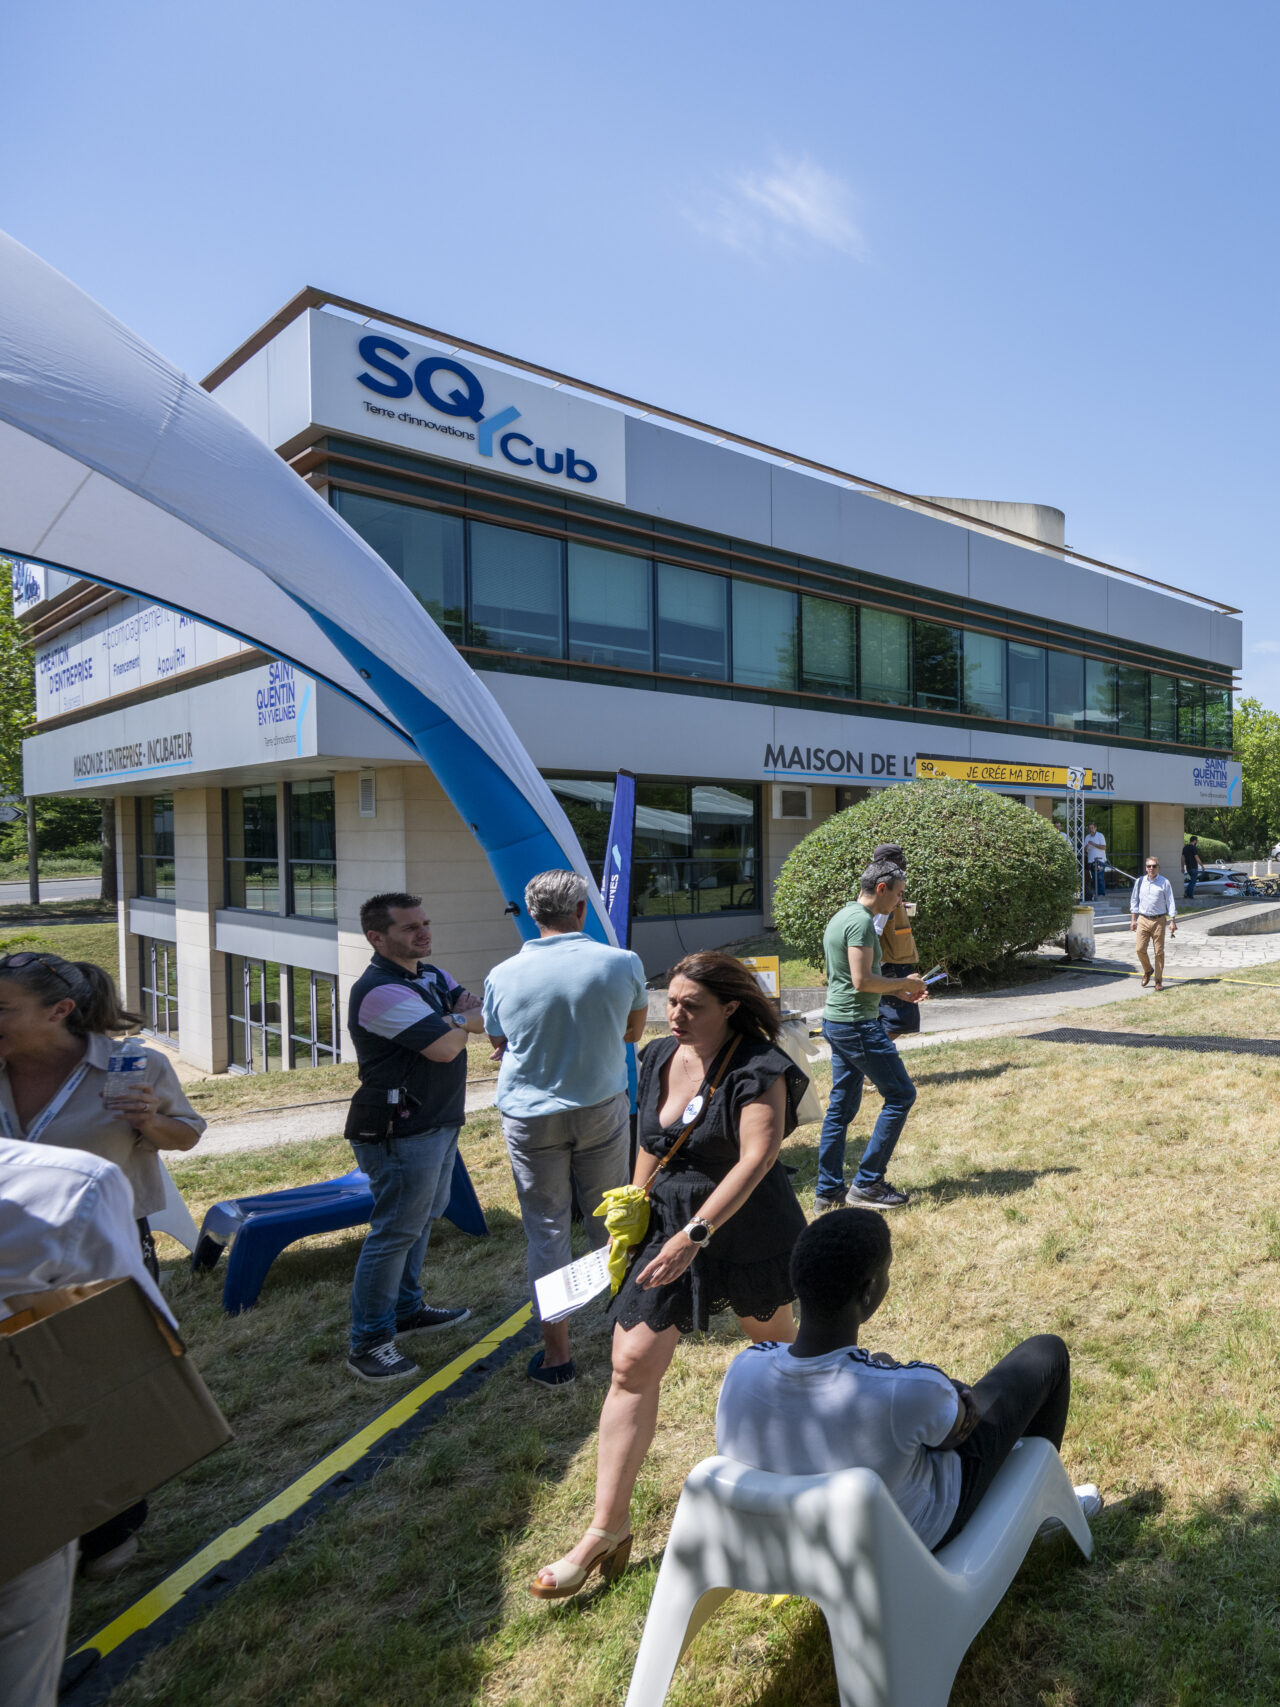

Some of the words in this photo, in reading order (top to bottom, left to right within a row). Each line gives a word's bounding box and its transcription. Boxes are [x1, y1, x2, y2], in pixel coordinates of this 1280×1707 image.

[363, 401, 396, 419] Terre
[398, 411, 476, 441] d'innovations
[500, 432, 598, 483] Cub
[176, 647, 187, 668] RH
[257, 681, 295, 710] QUENTIN
[258, 711, 267, 726] EN
[267, 705, 296, 725] YVELINES
[74, 752, 96, 777] MAISON
[96, 752, 103, 774] DE
[104, 743, 142, 772] L'ENTREPRISE
[147, 732, 193, 765] INCUBATEUR
[763, 743, 864, 774] MAISON
[871, 752, 896, 776] DE
[1205, 758, 1227, 770] SAINT
[966, 766, 979, 778] JE
[981, 765, 1007, 780] CRÉE
[1009, 768, 1023, 781] MA
[1193, 767, 1227, 781] QUENTIN
[1194, 779, 1202, 787] EN
[1203, 780, 1228, 789] YVELINES
